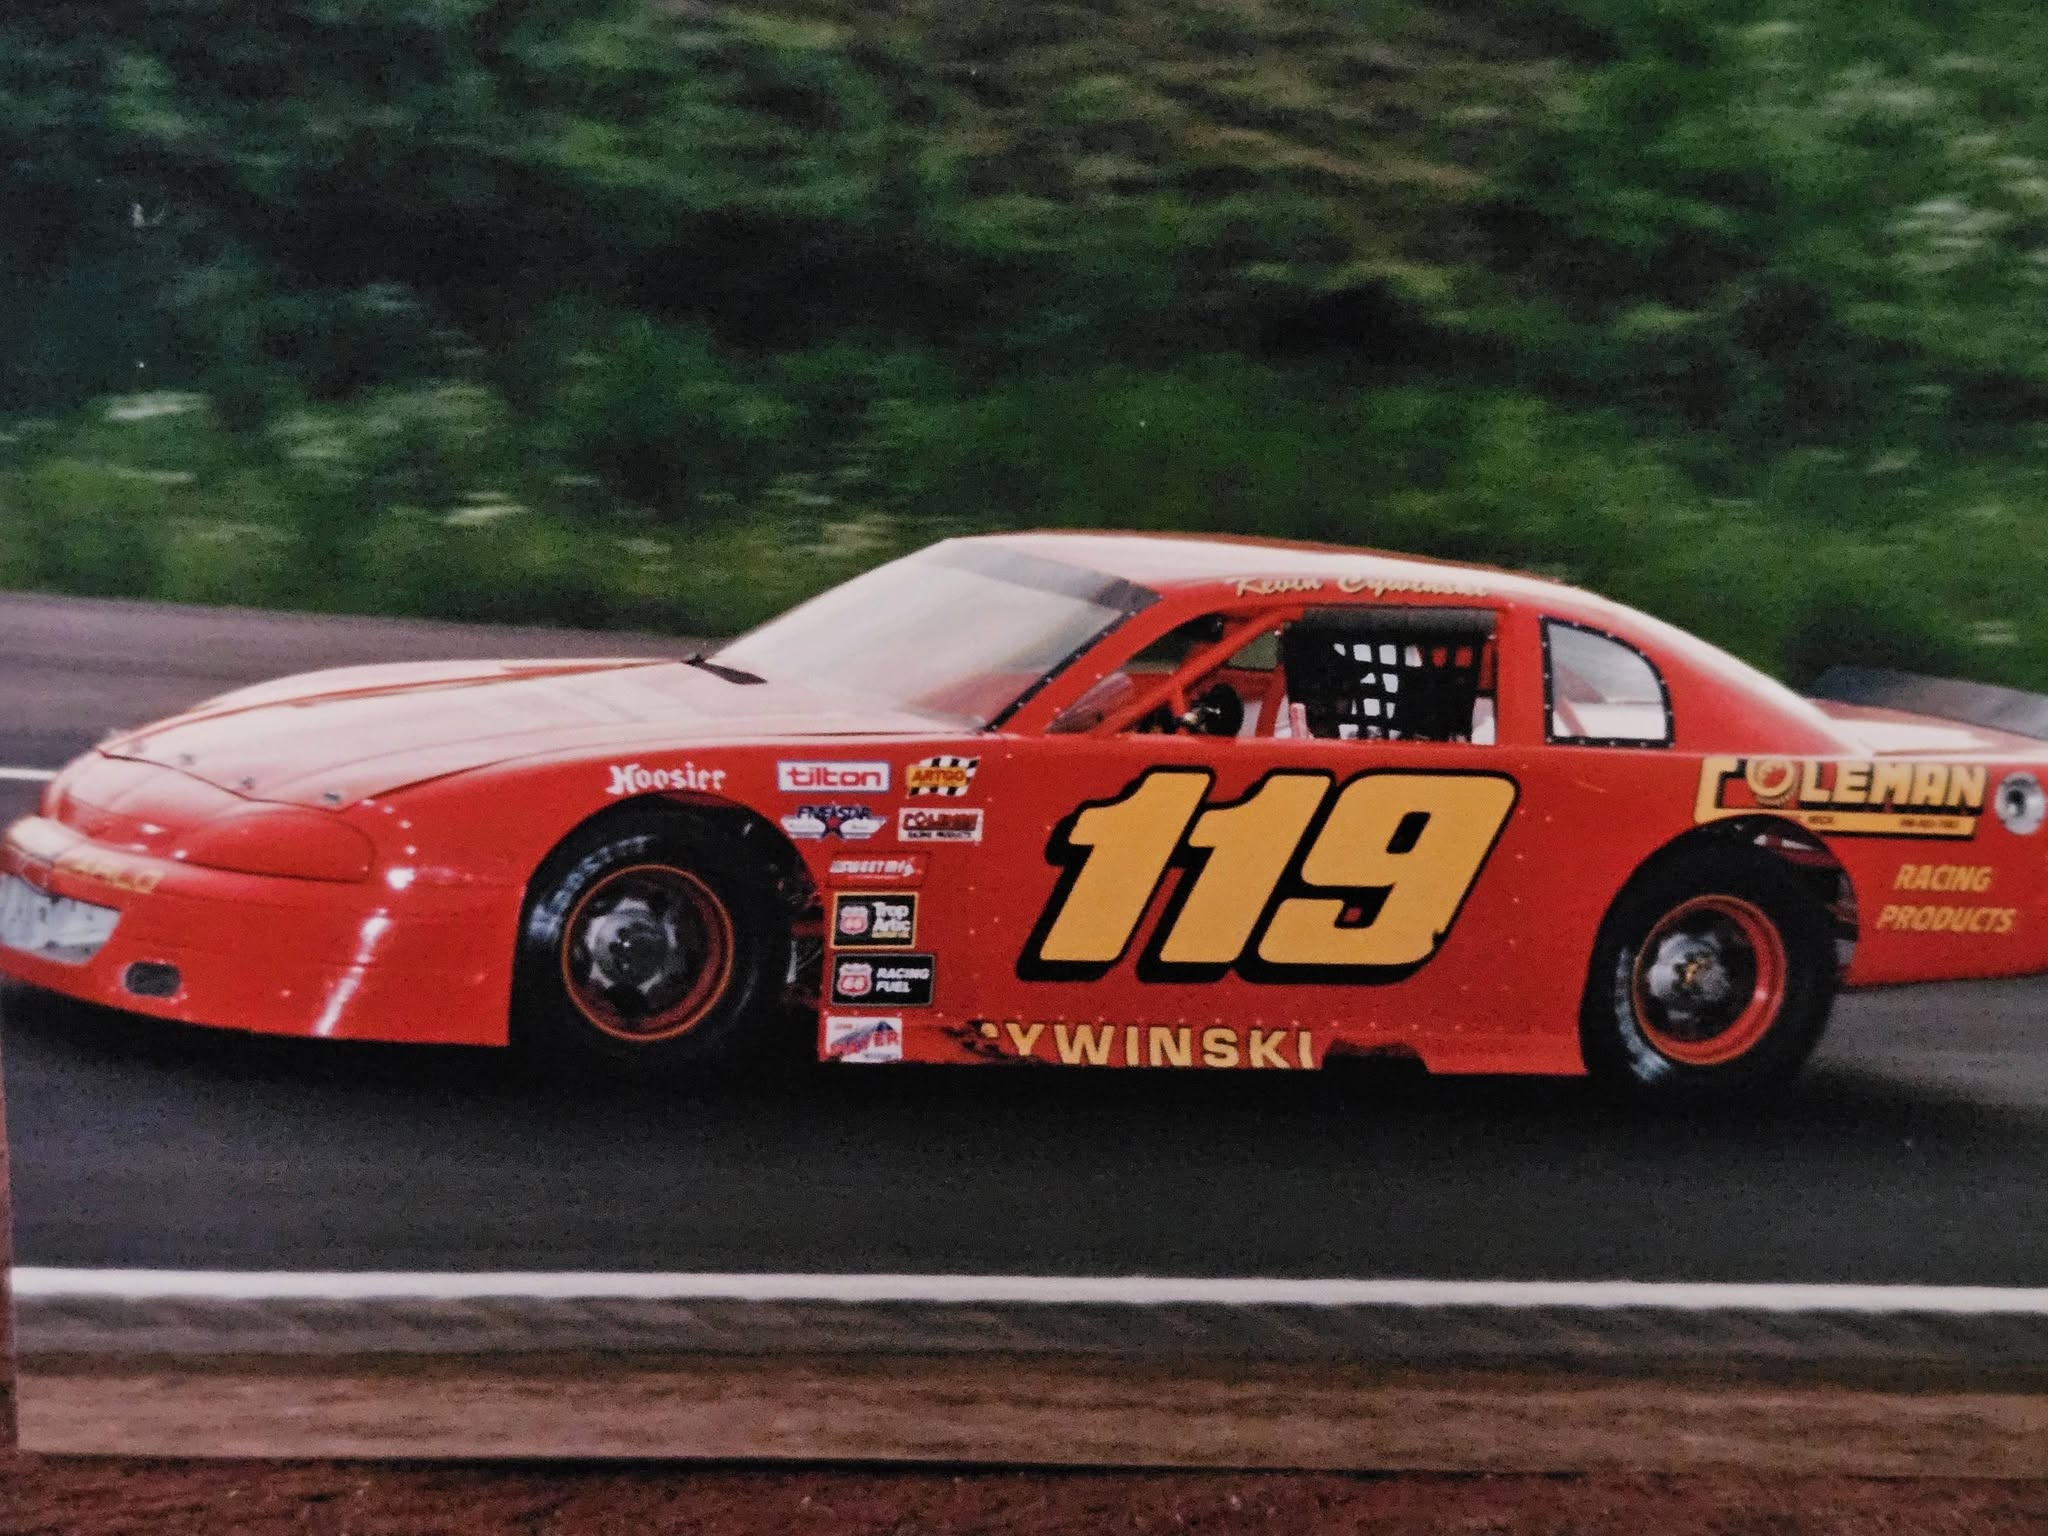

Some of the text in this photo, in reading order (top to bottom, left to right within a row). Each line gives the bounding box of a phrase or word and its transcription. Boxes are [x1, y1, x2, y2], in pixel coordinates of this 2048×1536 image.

[605, 761, 727, 795] Hoosier
[788, 767, 881, 786] tilton
[1694, 756, 1988, 825] COLEMAN
[1017, 766, 1520, 985] 119
[1895, 864, 1993, 892] RACING
[1876, 905, 2016, 933] PRODUCTS
[876, 968, 930, 980] RACING
[876, 981, 911, 993] FUEL
[980, 1022, 1314, 1070] YWINSKI
